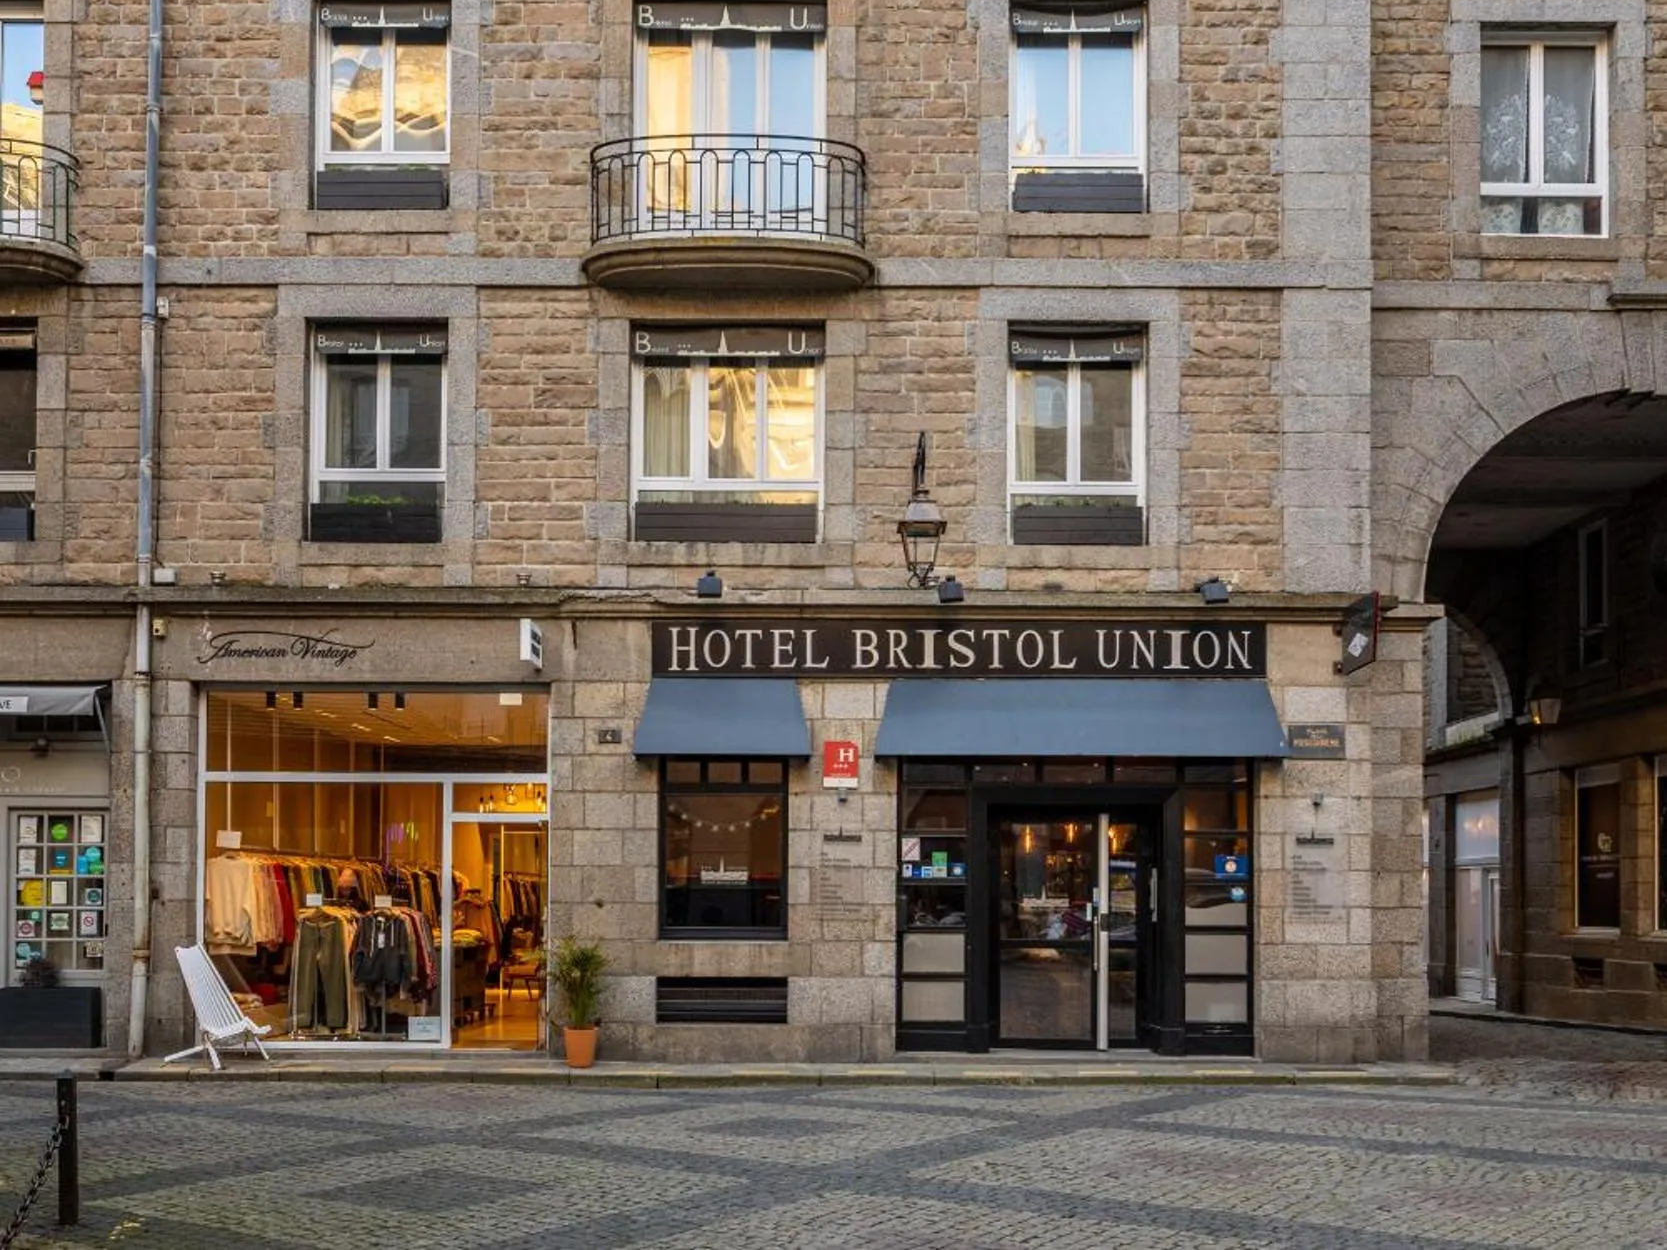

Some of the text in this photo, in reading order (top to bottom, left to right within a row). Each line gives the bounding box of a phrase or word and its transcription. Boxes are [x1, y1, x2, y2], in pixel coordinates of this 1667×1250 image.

[198, 630, 359, 667] American Vintage
[667, 627, 1253, 671] HOTEL BRISTOL UNION
[838, 748, 855, 763] H
